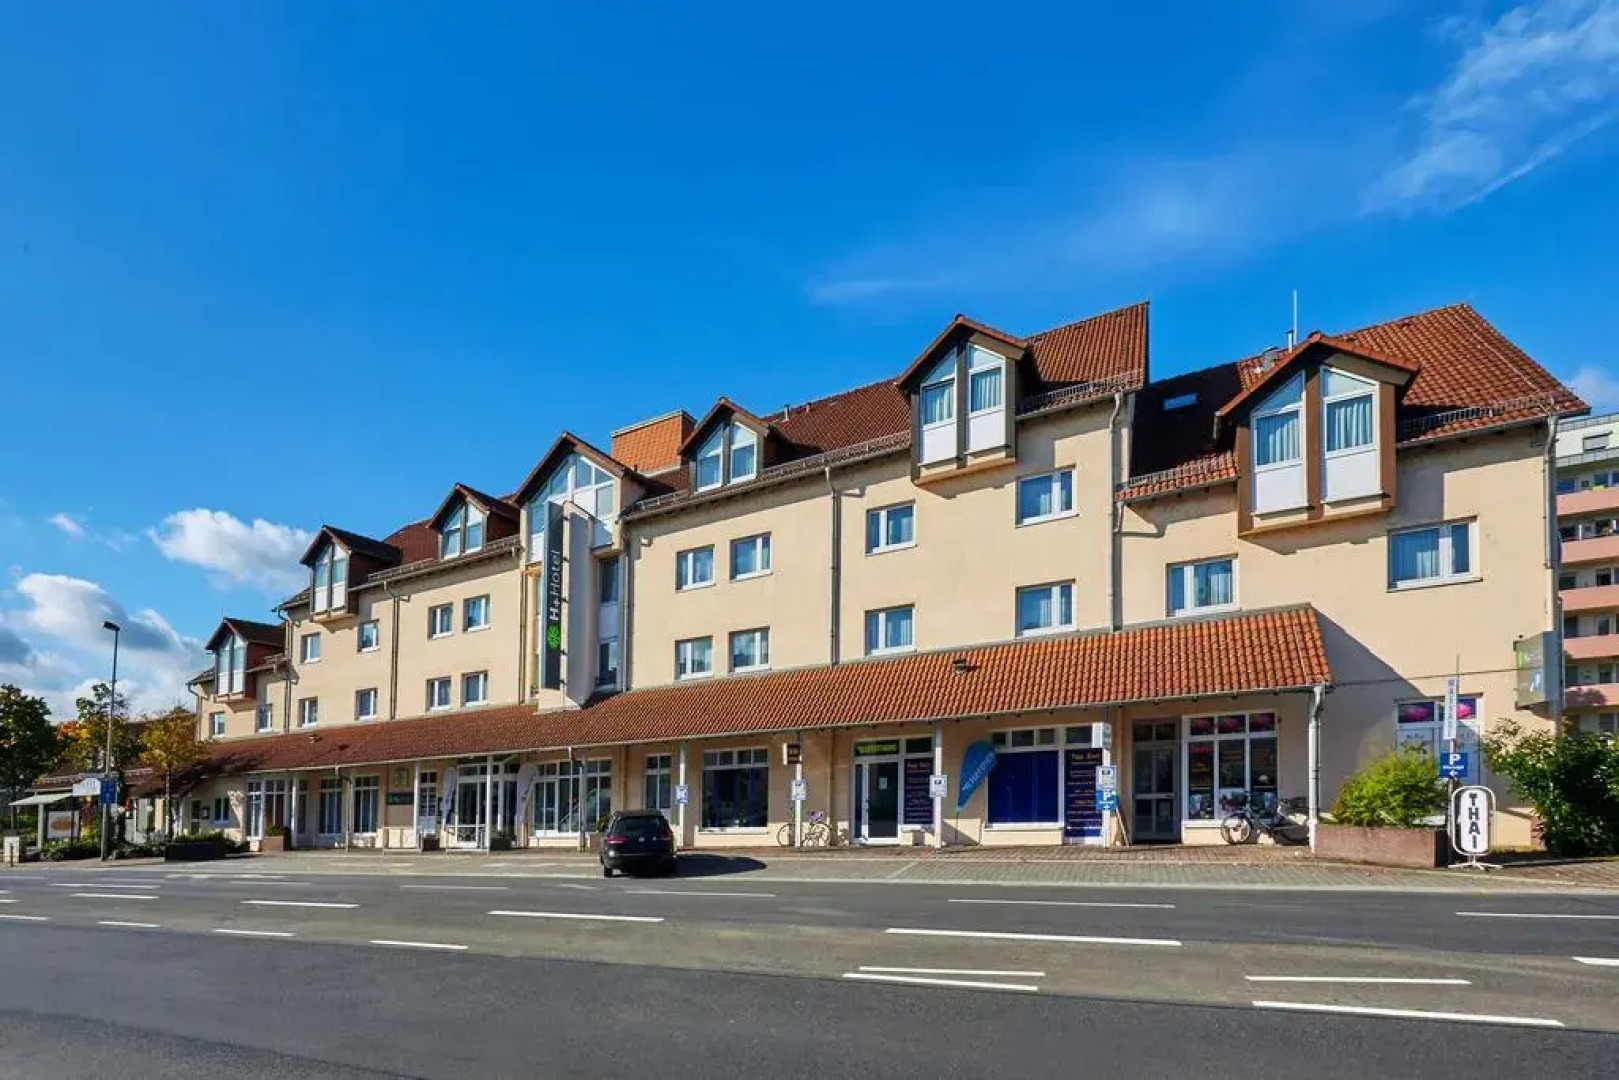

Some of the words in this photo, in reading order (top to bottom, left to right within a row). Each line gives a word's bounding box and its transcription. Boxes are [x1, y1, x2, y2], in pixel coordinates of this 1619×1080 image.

[549, 550, 561, 621] H+Hotel
[1449, 753, 1461, 765] P
[1468, 793, 1481, 849] THAI
